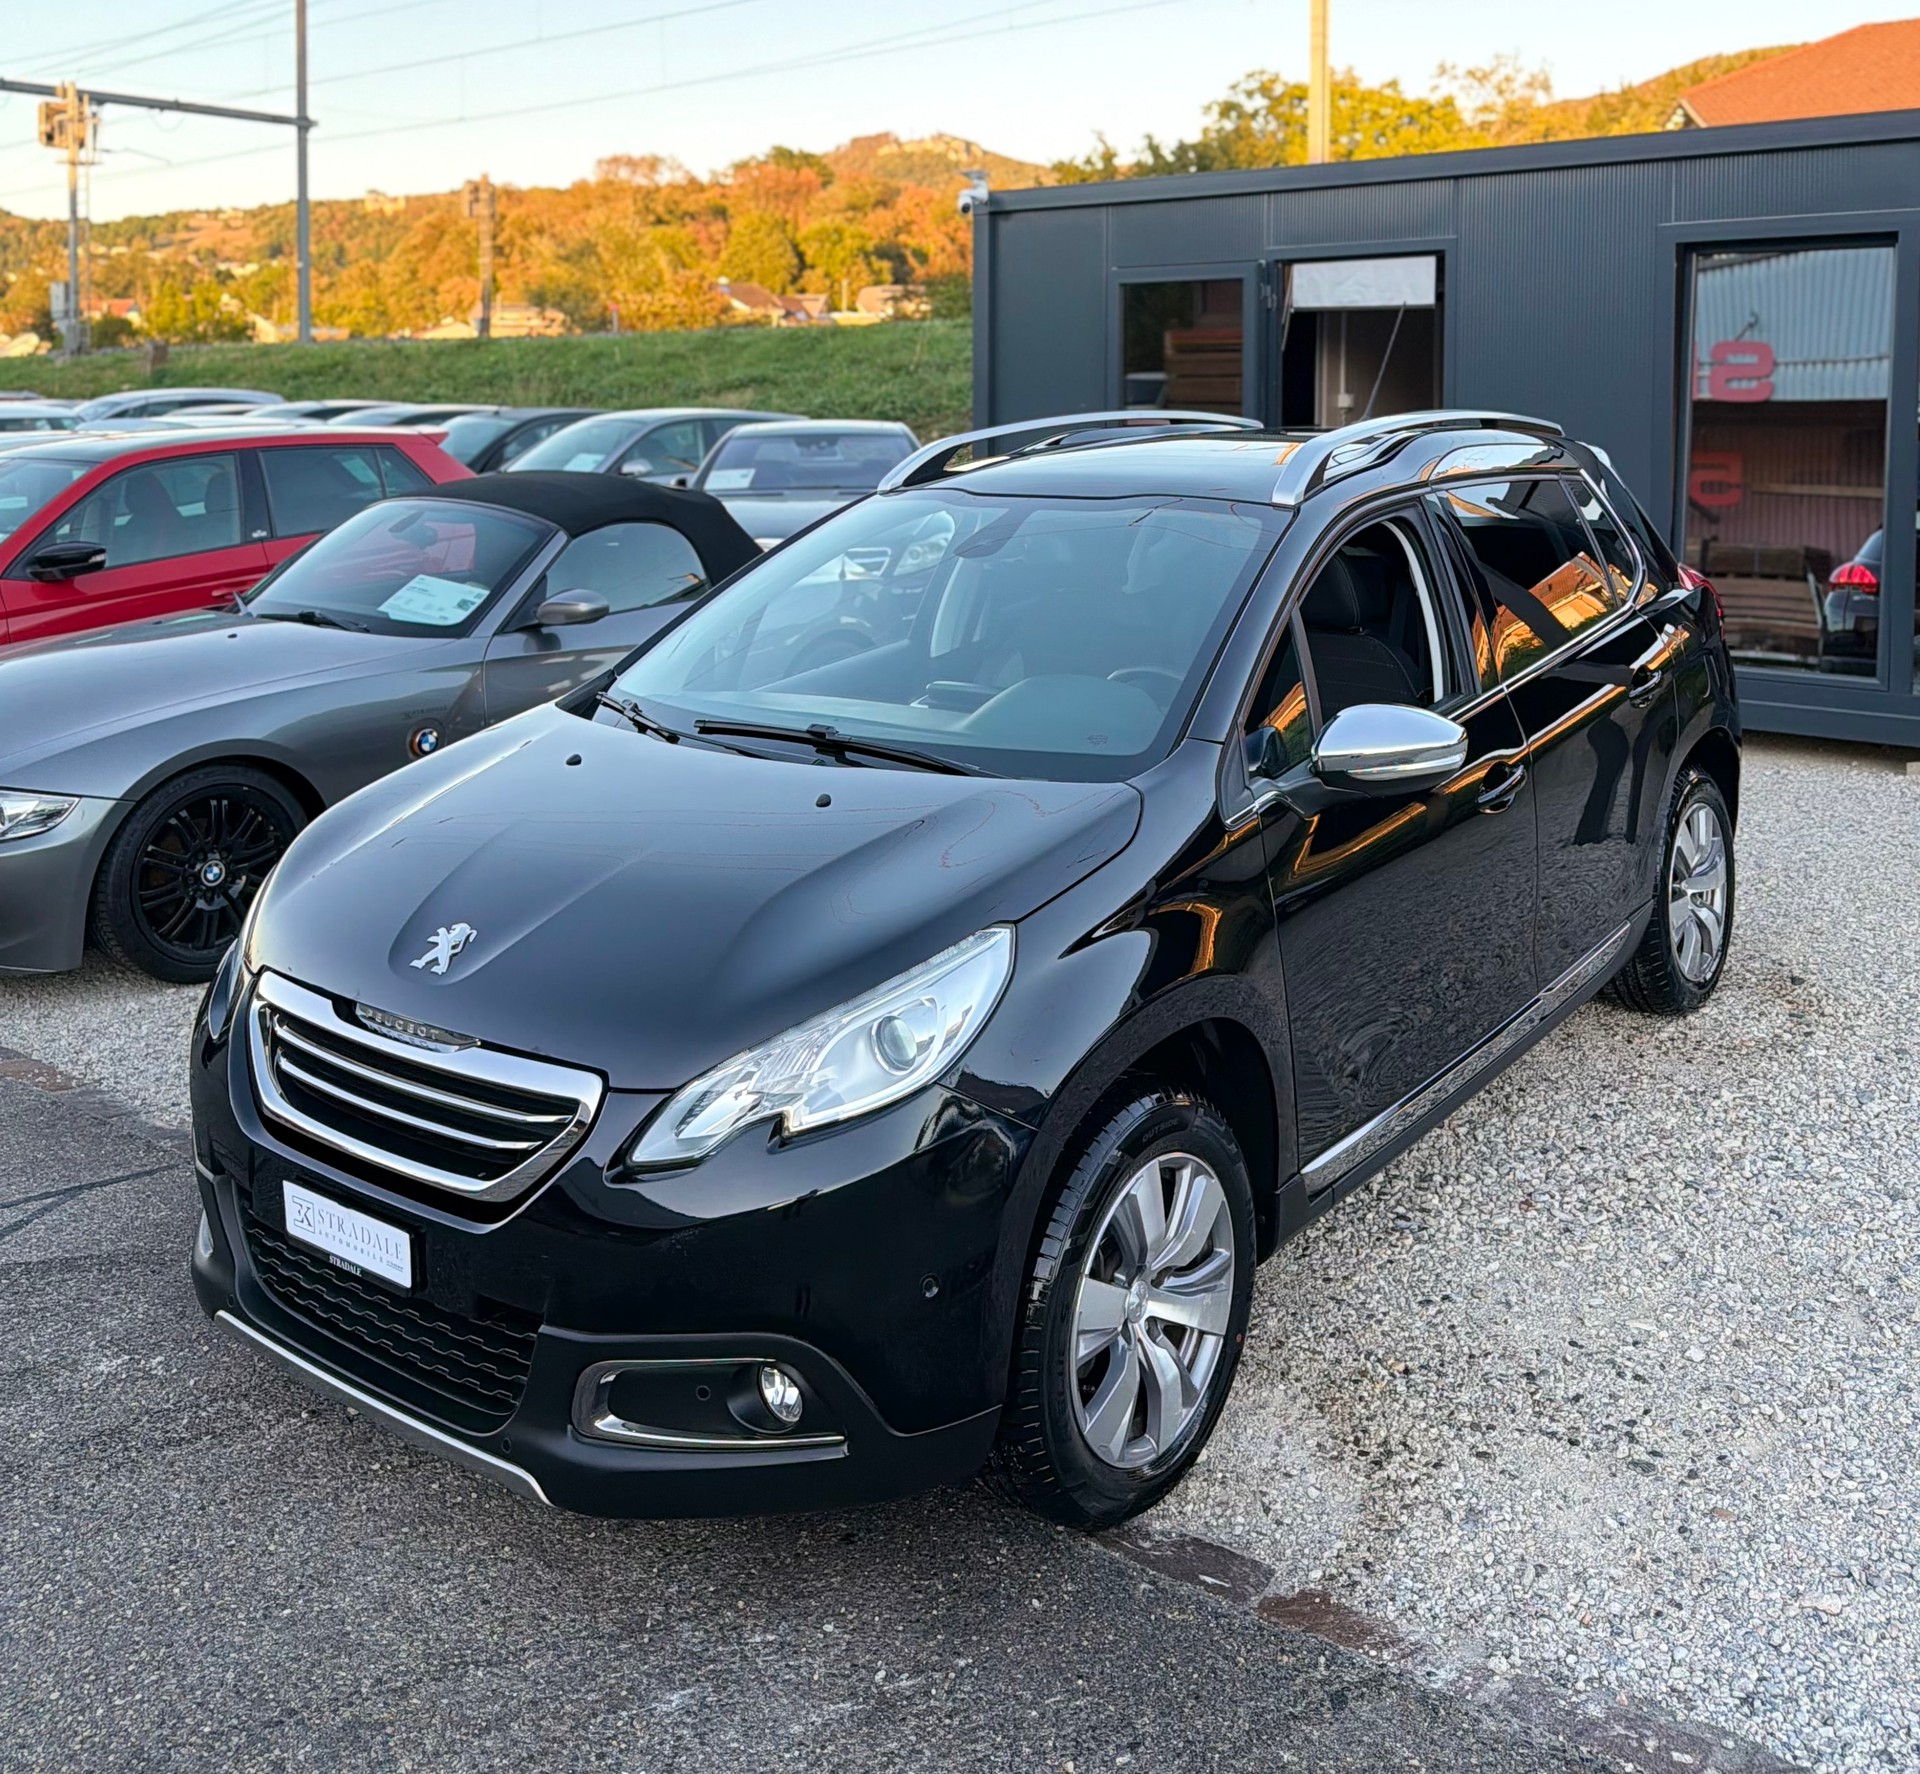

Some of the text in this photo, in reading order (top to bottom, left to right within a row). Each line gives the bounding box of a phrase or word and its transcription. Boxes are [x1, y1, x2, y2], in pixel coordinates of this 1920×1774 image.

[364, 1008, 439, 1039] PEUGEOT
[1142, 1118, 1179, 1142] OUTSIDE
[317, 1208, 403, 1261] STRADALE
[328, 1255, 362, 1277] STRADALE
